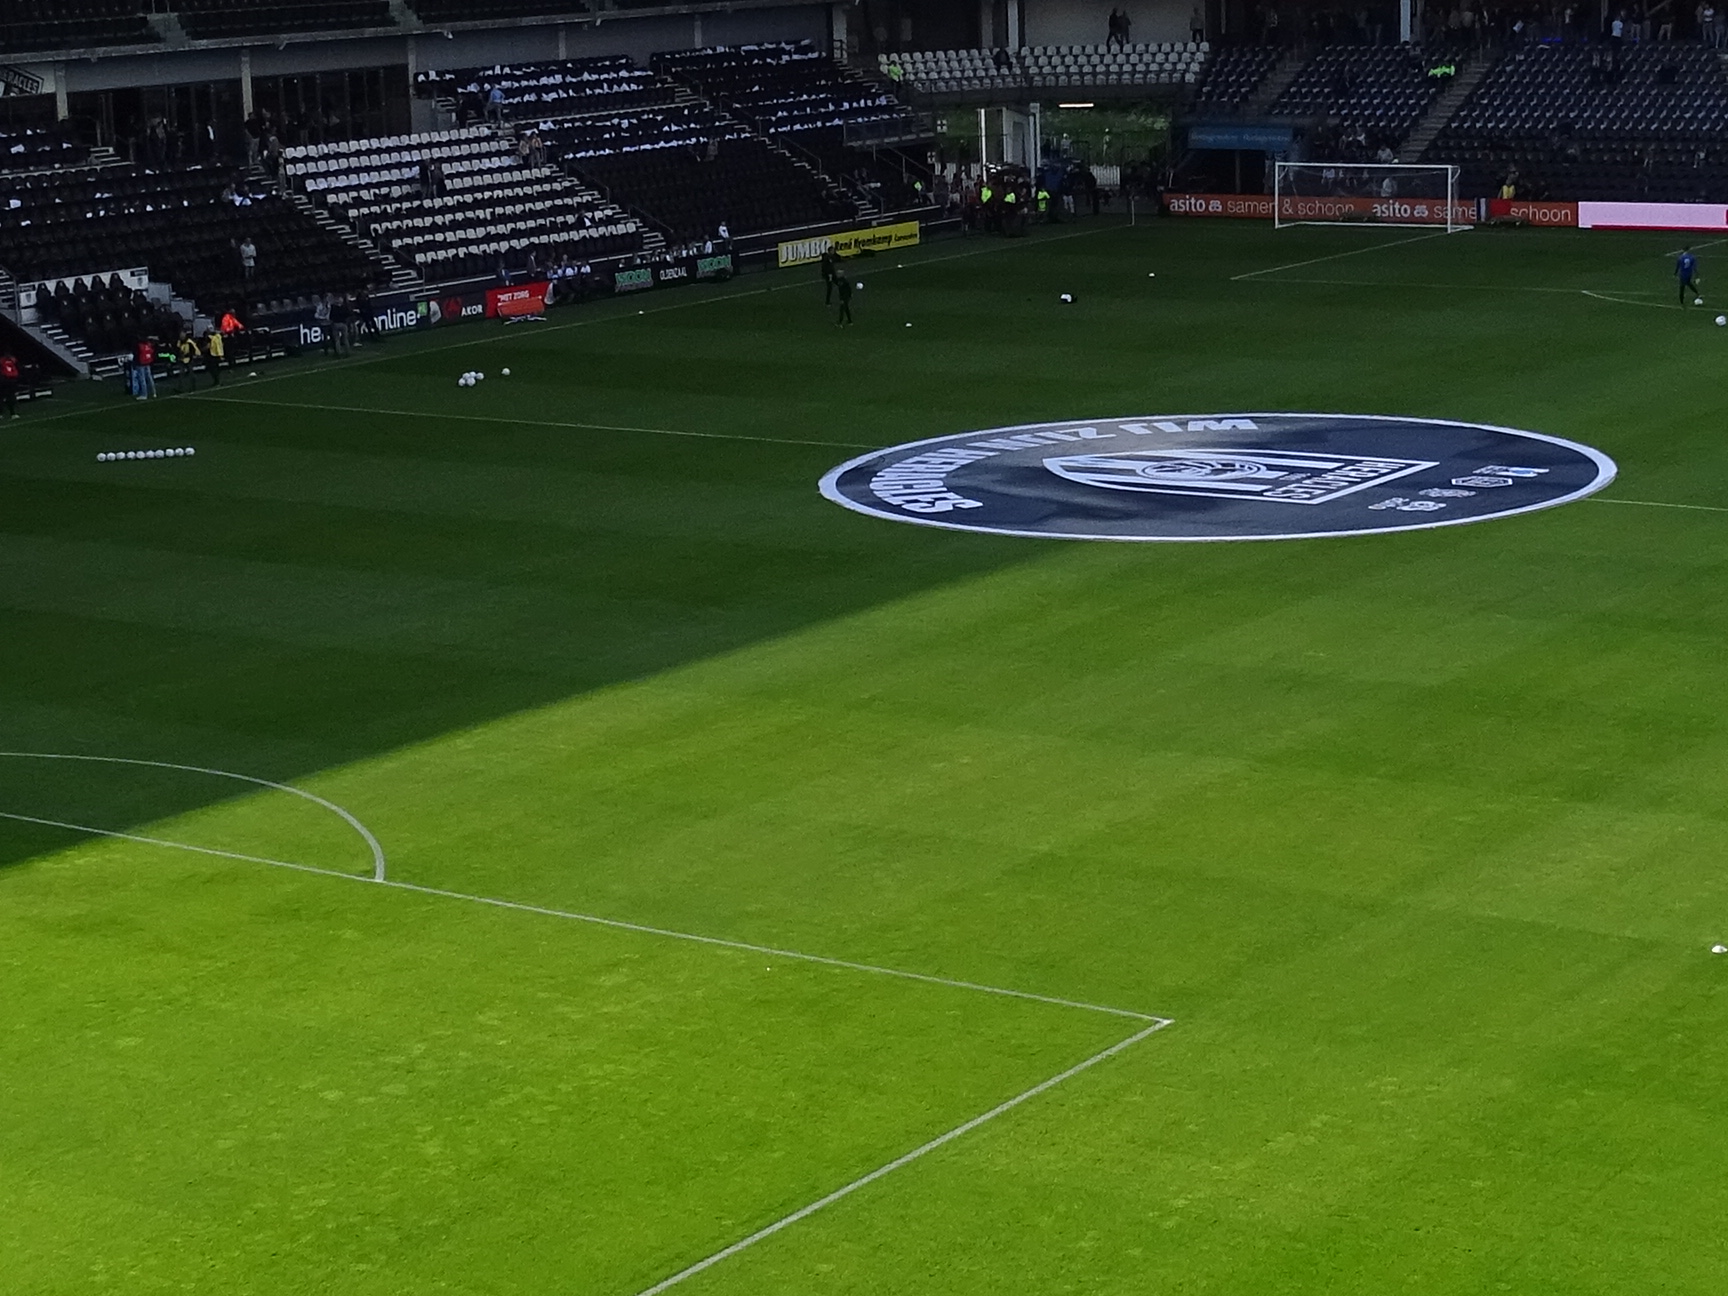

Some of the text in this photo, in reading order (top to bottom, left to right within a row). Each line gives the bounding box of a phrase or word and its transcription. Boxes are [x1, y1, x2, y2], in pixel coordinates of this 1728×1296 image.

[1169, 195, 1206, 213] asito
[1282, 199, 1294, 214] &
[1371, 199, 1411, 218] asito
[1433, 203, 1478, 218] same
[460, 304, 483, 317] AKOR
[868, 447, 1000, 515] HERACLES
